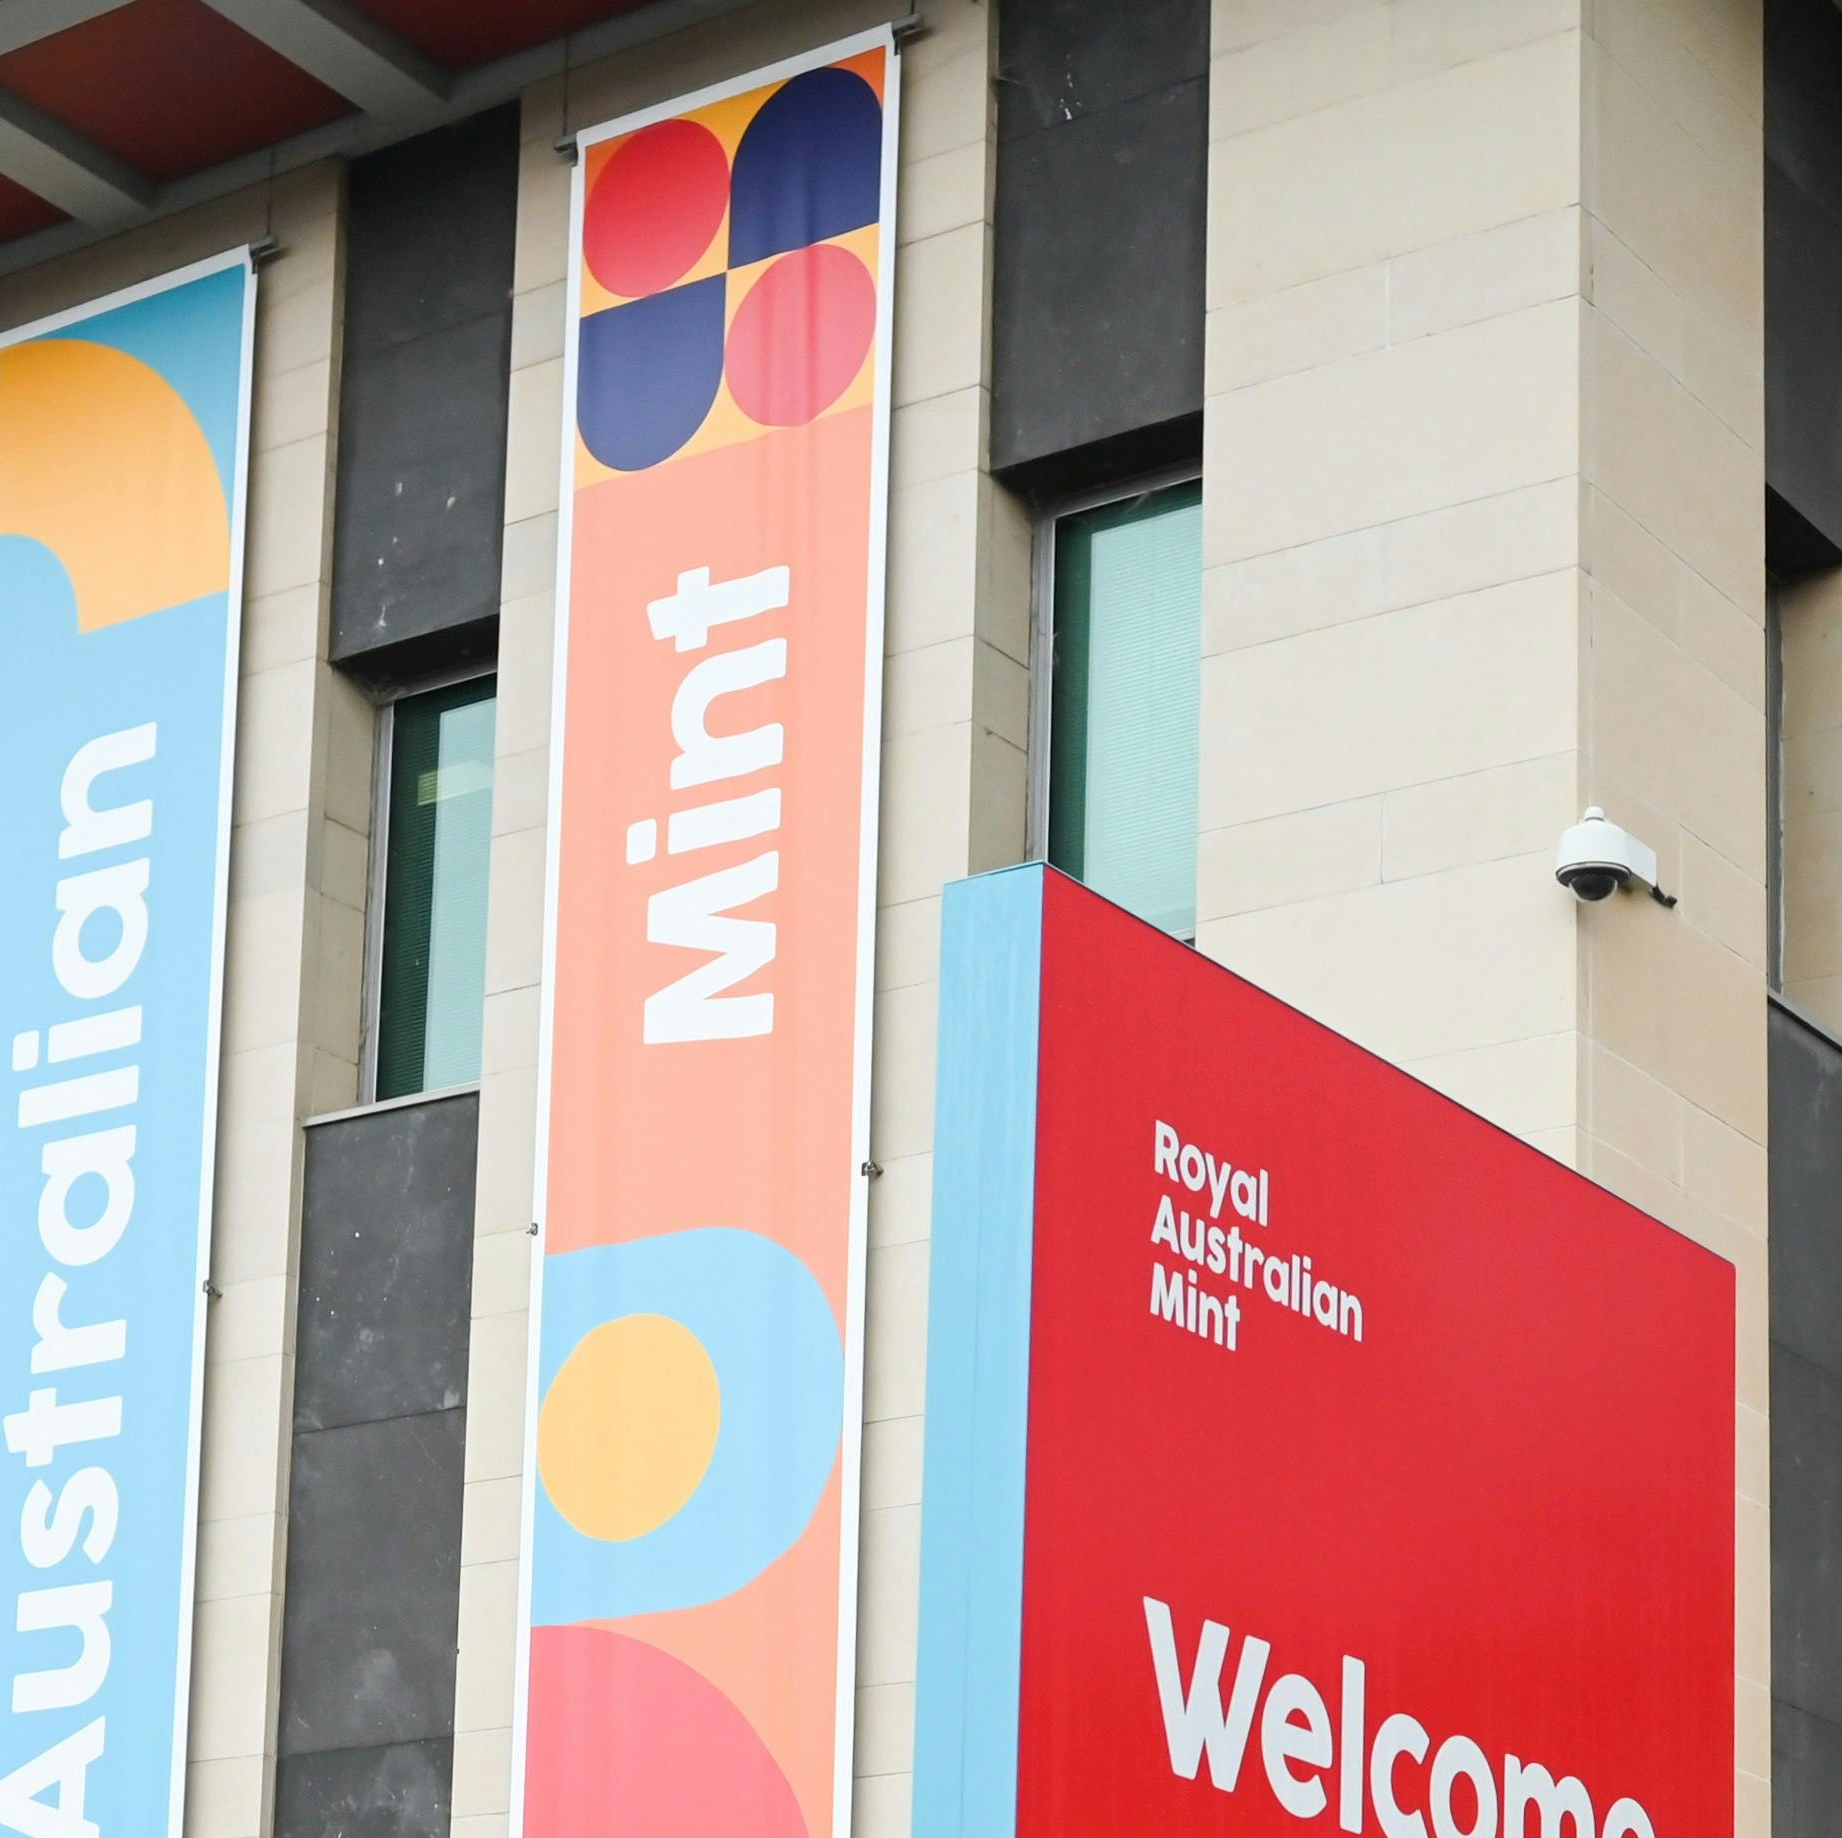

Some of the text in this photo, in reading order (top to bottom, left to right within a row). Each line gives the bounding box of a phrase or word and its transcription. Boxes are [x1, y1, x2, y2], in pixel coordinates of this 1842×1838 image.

[624, 564, 791, 1046] Mint
[1153, 1118, 1270, 1229] Royal
[1148, 1260, 1242, 1353] Mint
[1149, 1193, 1365, 1344] Australian
